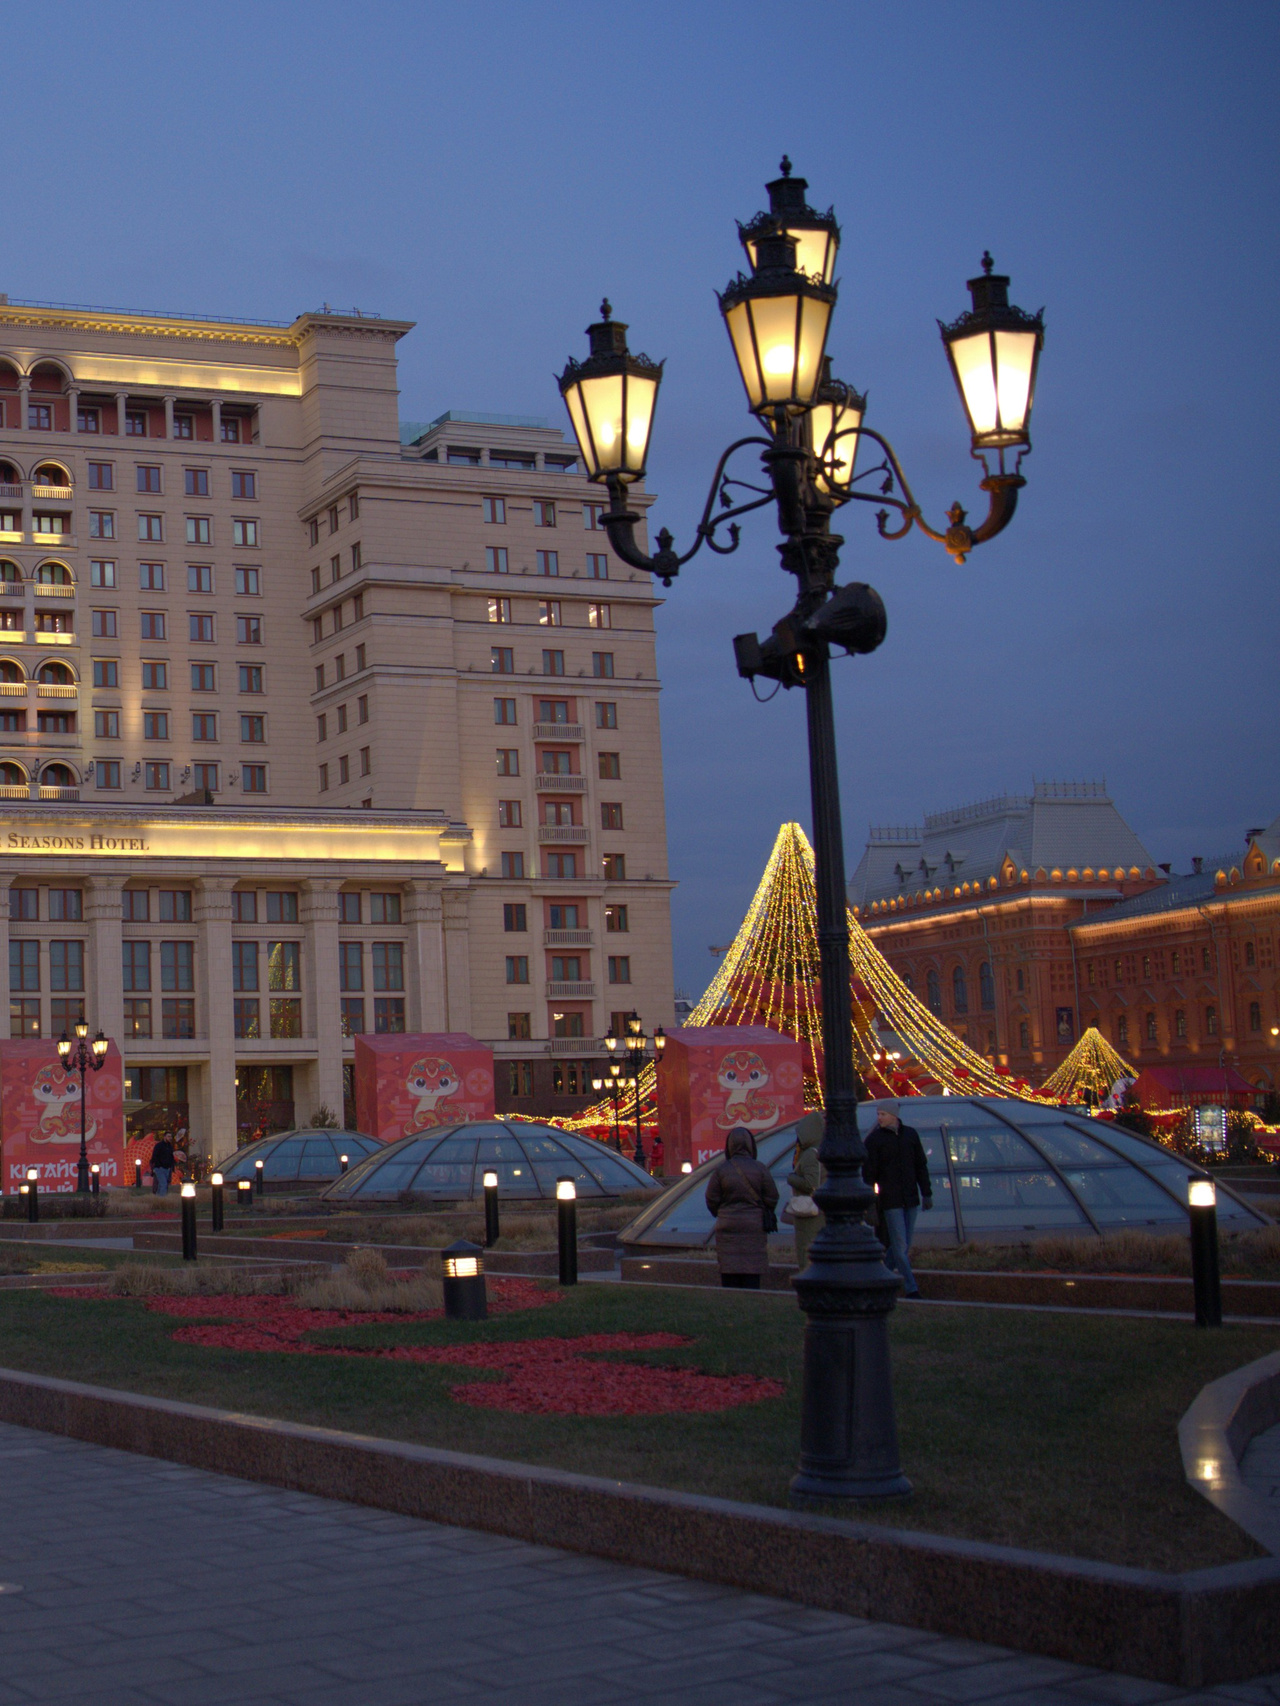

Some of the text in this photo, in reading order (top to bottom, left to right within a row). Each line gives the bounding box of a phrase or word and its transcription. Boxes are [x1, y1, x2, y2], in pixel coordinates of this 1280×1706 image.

[8, 832, 84, 849] SEASONS
[90, 834, 150, 850] HOTEL
[10, 1158, 117, 1179] КИТАЙСИЙ
